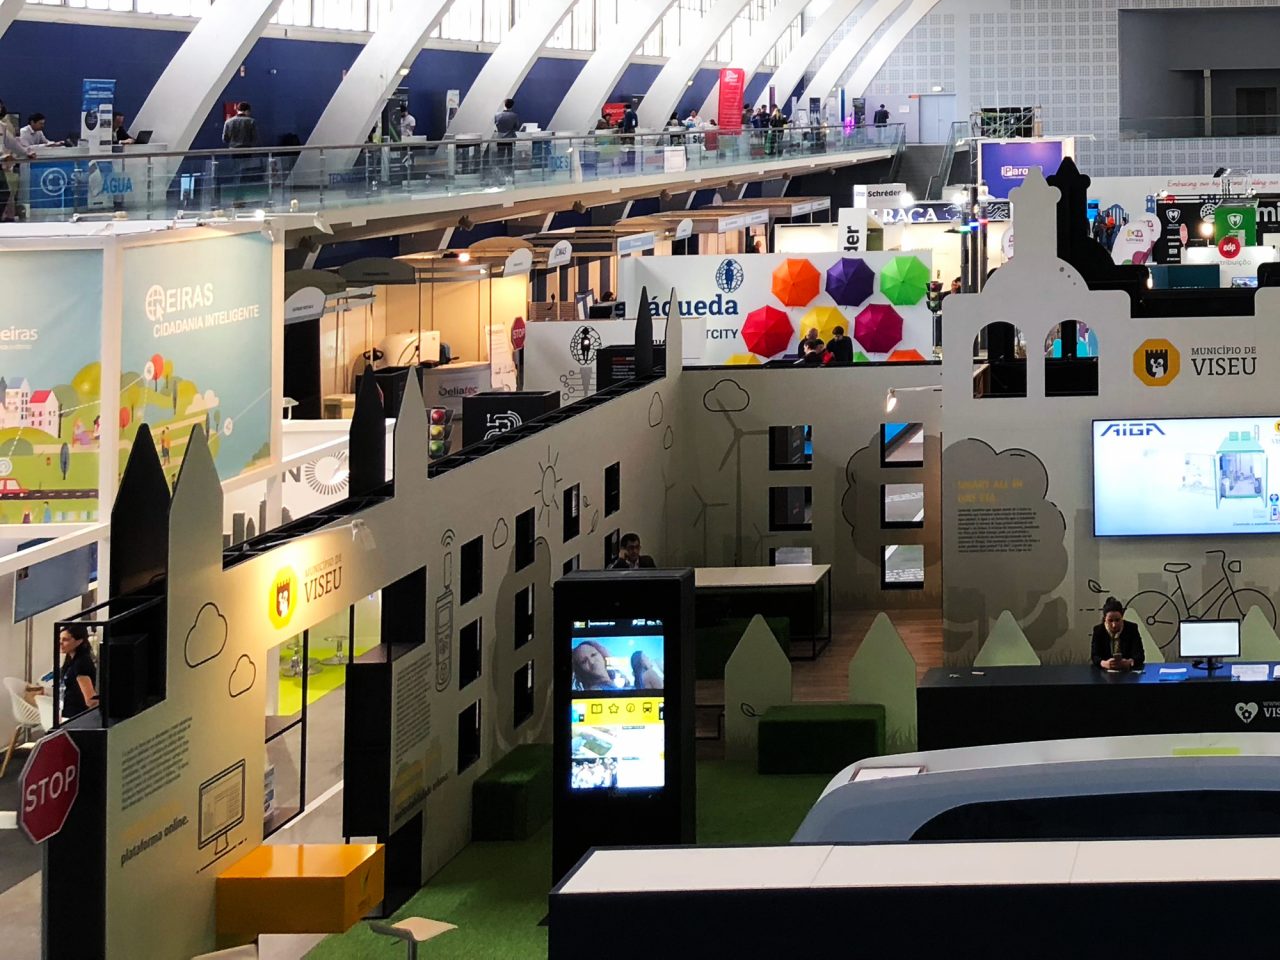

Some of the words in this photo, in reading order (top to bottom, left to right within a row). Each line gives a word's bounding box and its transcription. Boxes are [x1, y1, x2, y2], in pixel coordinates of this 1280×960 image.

[153, 316, 204, 338] CIDADANIA
[205, 304, 260, 327] INTELIGENTE
[512, 328, 525, 340] STOP
[1191, 345, 1241, 356] MUNICÍPIO
[1244, 346, 1257, 355] DE
[1191, 357, 1257, 376] VISEU
[304, 566, 343, 603] VISEU
[26, 765, 76, 812] STOP
[121, 831, 162, 868] plataforma
